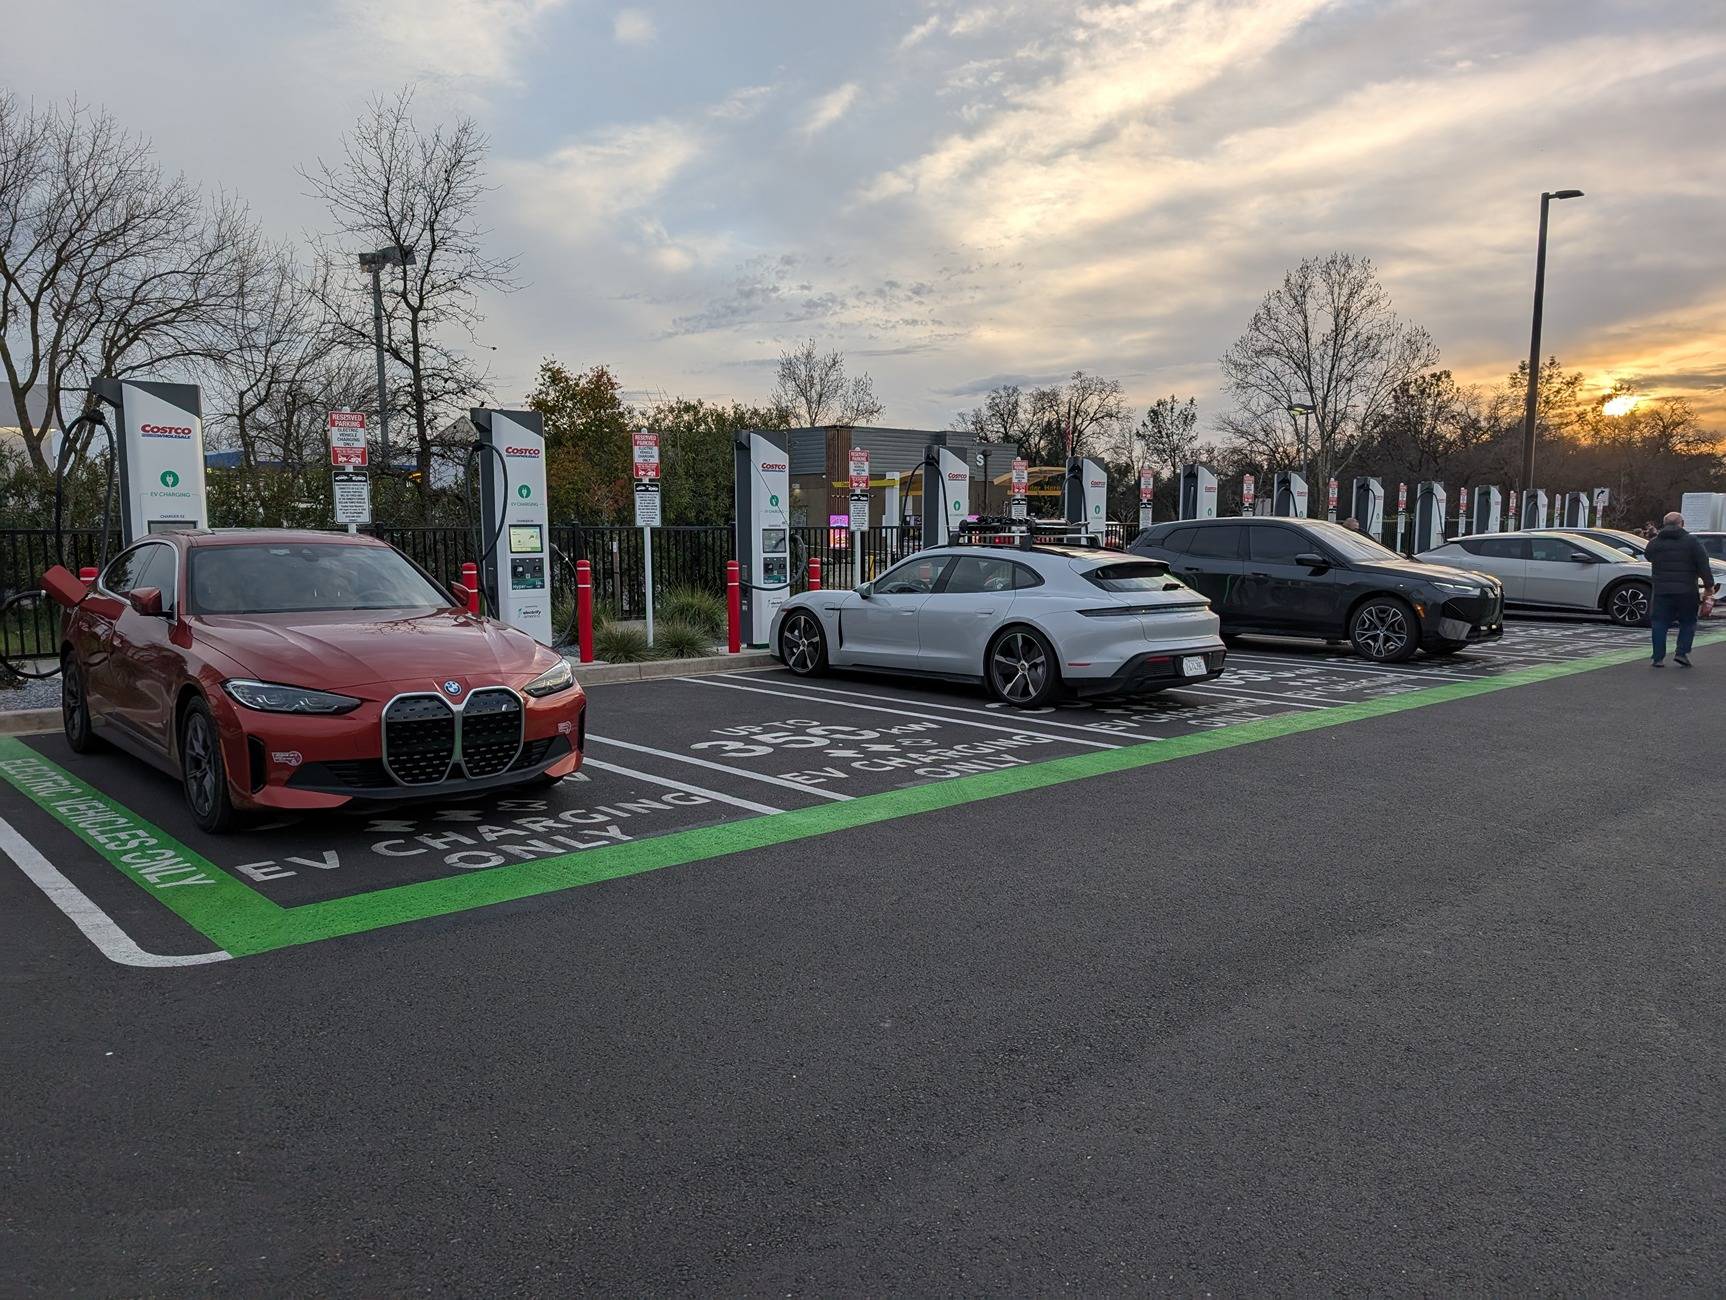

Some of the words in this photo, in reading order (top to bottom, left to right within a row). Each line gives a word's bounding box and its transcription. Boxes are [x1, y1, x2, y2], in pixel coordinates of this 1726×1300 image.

[332, 413, 363, 421] RESERVED
[335, 420, 361, 428] PARKING
[140, 423, 192, 435] COSTCO
[505, 446, 541, 456] COSTCO
[761, 462, 787, 470] COSTCO
[976, 454, 985, 466] S
[710, 725, 764, 737] UP
[761, 718, 821, 731] TO
[1085, 719, 1140, 731] EV
[690, 725, 881, 757] 350
[777, 767, 850, 785] EV
[850, 734, 1054, 772] CHARGING
[914, 753, 1031, 778] ONLY
[0, 757, 83, 798] ELECTRIC
[51, 795, 158, 851] VEHICLES
[119, 849, 216, 889] ONLY
[234, 850, 340, 882] EV
[369, 791, 712, 857] CHARGING
[443, 825, 634, 869] ONLY
